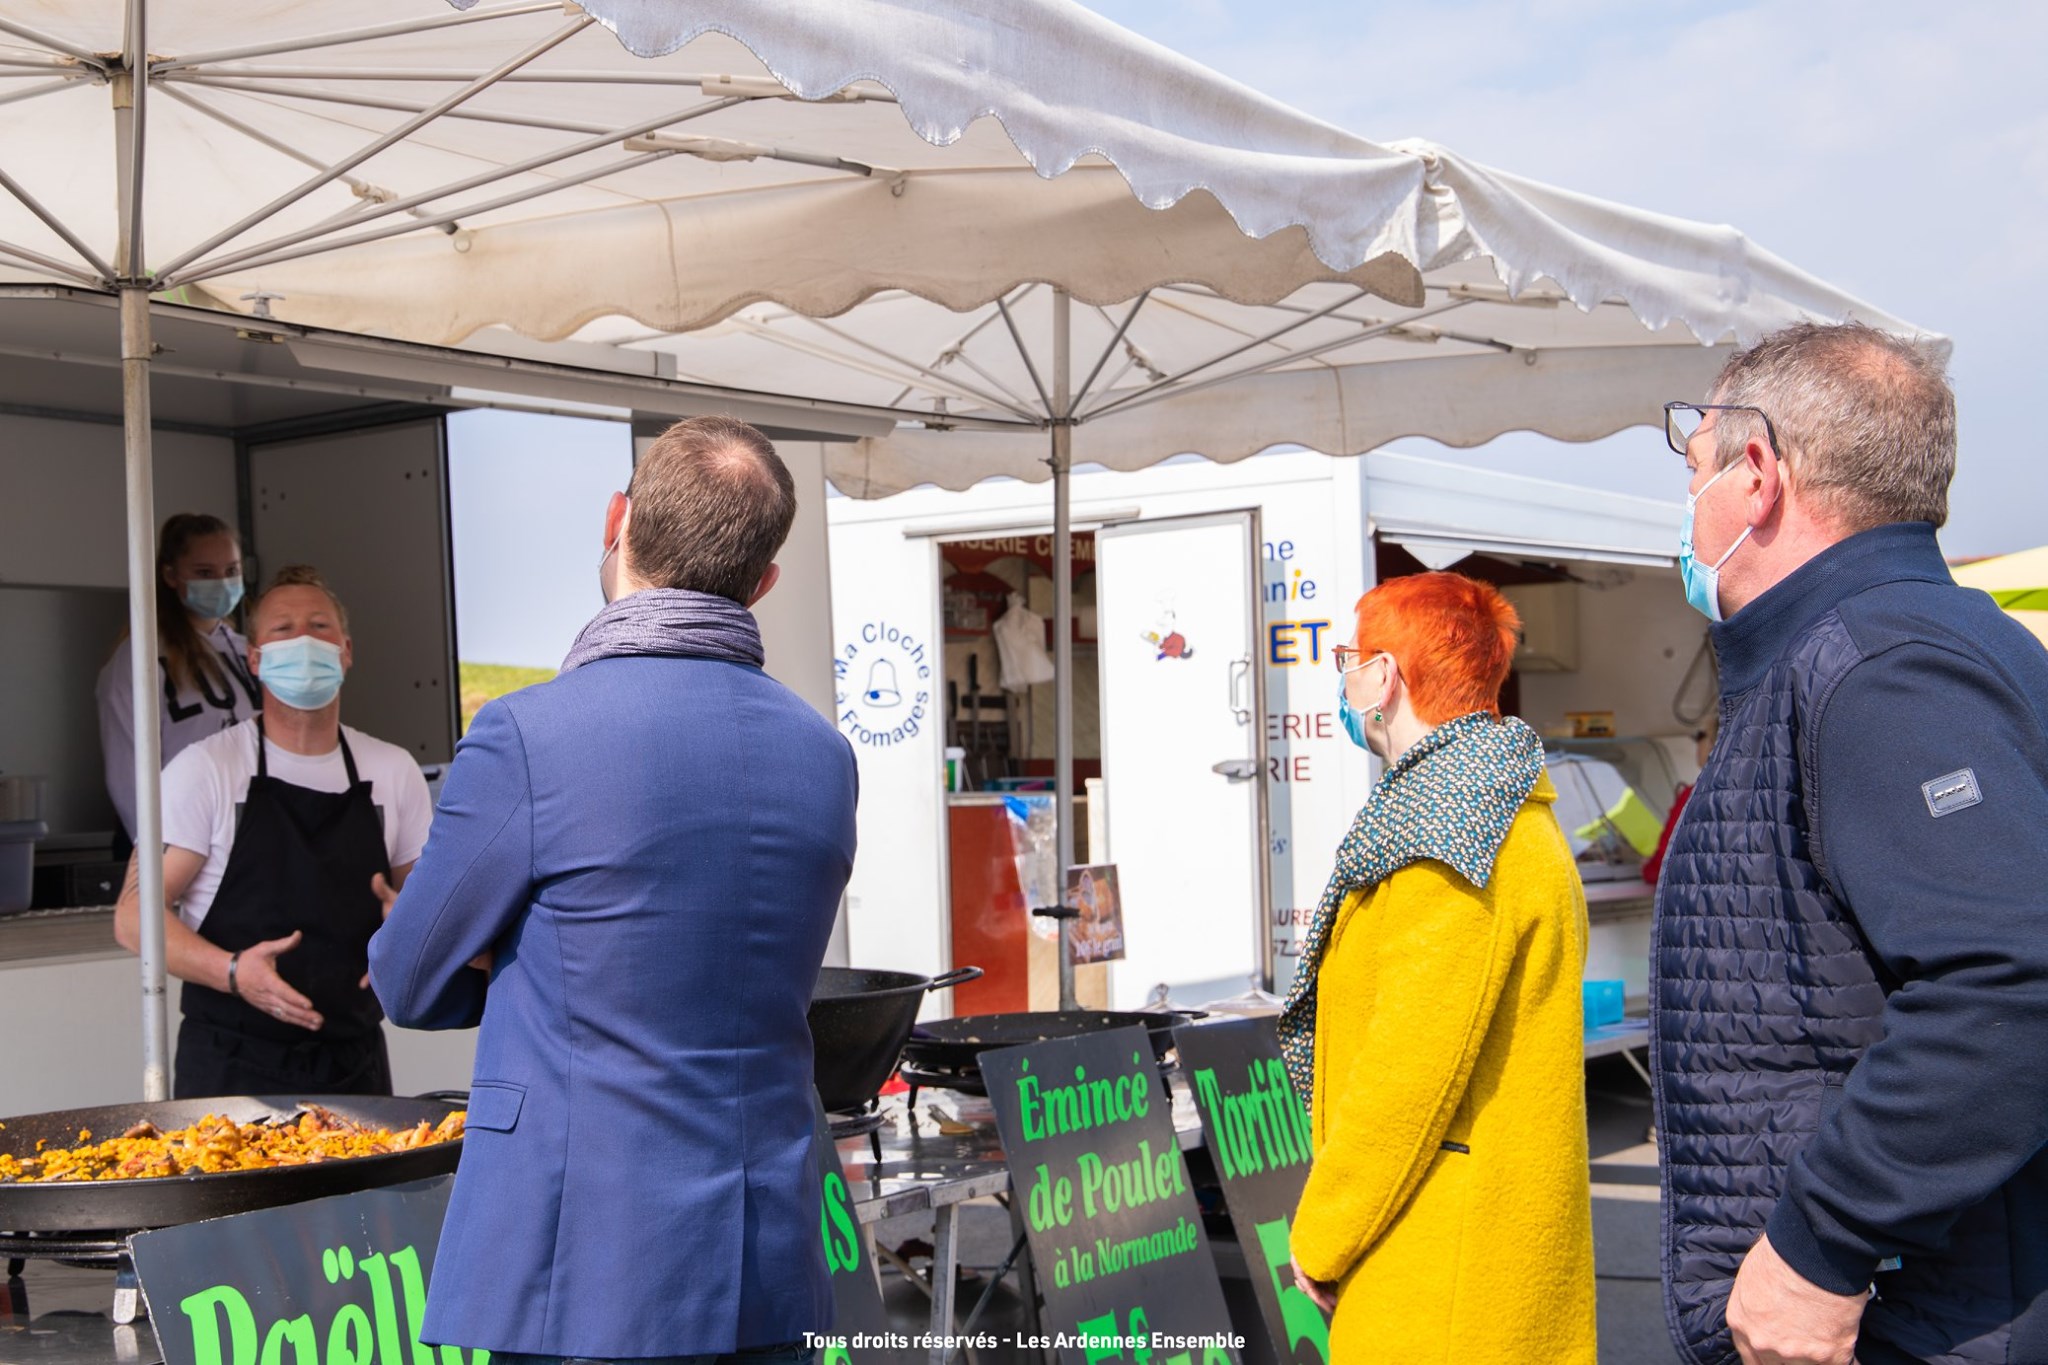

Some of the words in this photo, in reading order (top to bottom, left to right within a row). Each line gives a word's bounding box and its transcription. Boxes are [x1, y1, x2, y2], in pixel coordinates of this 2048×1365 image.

[862, 621, 930, 680] Cloche
[841, 691, 929, 747] Fromages
[1016, 1051, 1149, 1142] Émincé
[1028, 1163, 1073, 1233] de
[1077, 1136, 1186, 1220] Poulet
[1054, 1248, 1071, 1288] à
[1070, 1246, 1095, 1284] la
[1095, 1216, 1198, 1275] Normande
